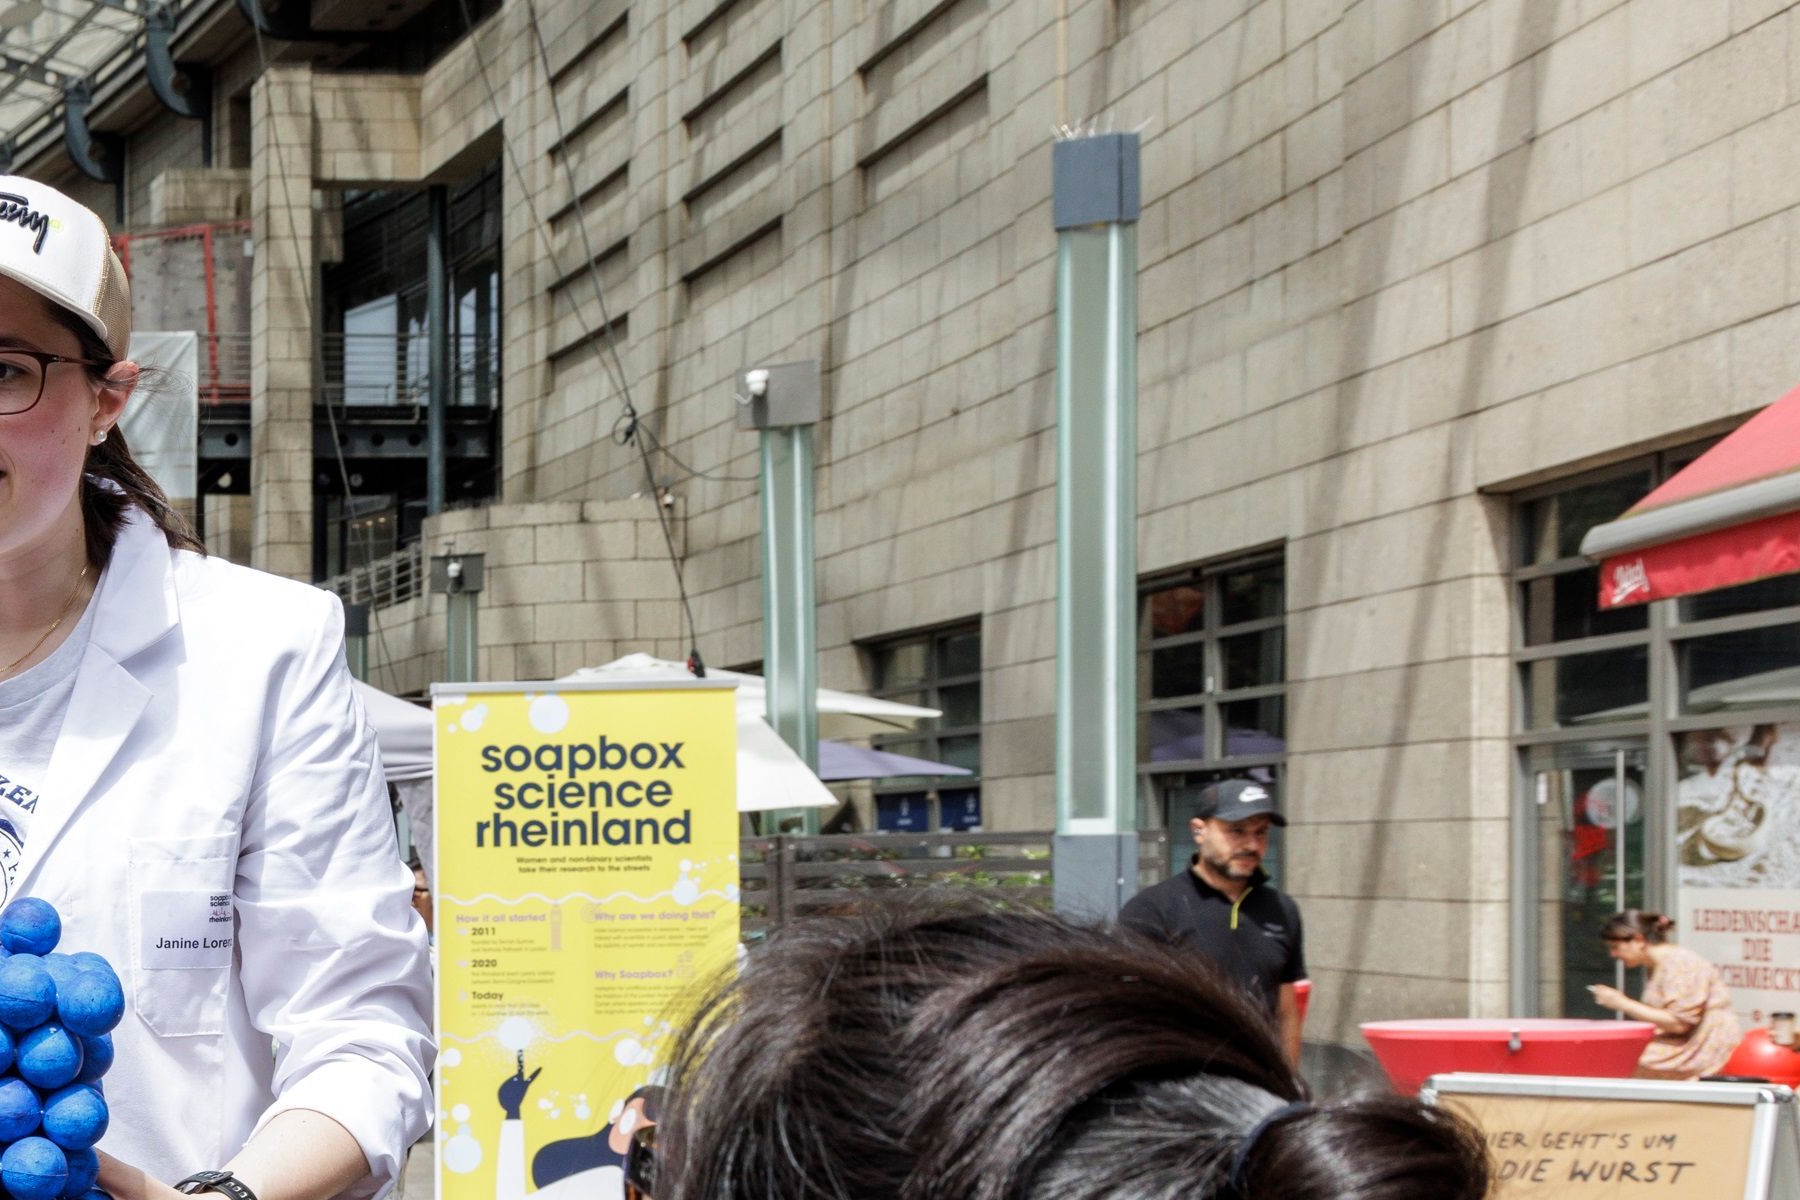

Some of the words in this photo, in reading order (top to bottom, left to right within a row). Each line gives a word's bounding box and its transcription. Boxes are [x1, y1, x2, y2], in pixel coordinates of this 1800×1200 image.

[481, 735, 686, 779] soapbox
[494, 774, 673, 809] science
[476, 810, 691, 847] rheinland
[568, 856, 612, 864] non-binary
[539, 865, 557, 873] their
[560, 865, 595, 873] research
[456, 914, 479, 923] How
[483, 914, 489, 922] it
[492, 914, 506, 922] all
[509, 913, 546, 922] started
[594, 912, 616, 923] Why
[658, 911, 689, 922] doing
[691, 910, 716, 920] this?
[472, 927, 496, 936] 2011
[156, 937, 199, 949] Janine
[472, 959, 497, 968] 2020
[594, 970, 616, 981] Why
[619, 969, 673, 980] Soapbox?
[472, 991, 504, 1002] Today
[1542, 1132, 1631, 1150] GEHT'S
[1643, 1133, 1677, 1150] UM
[1499, 1159, 1553, 1182] DIE
[1568, 1160, 1695, 1184] WURST
